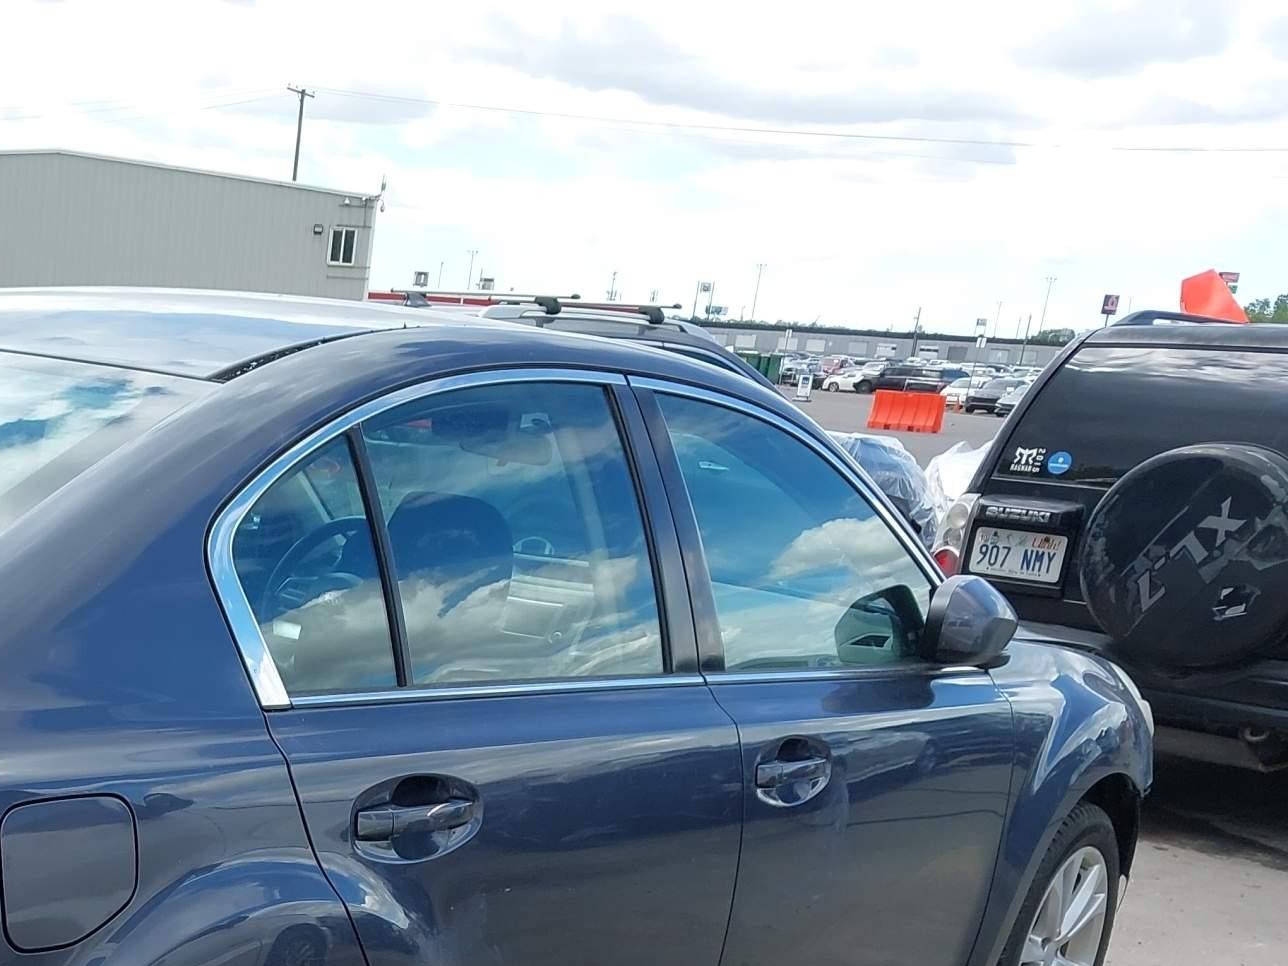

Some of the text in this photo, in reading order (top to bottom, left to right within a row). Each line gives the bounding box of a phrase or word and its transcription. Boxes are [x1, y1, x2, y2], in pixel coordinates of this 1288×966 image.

[985, 506, 1051, 524] SUZUKI
[976, 543, 1057, 574] 907 NMY
